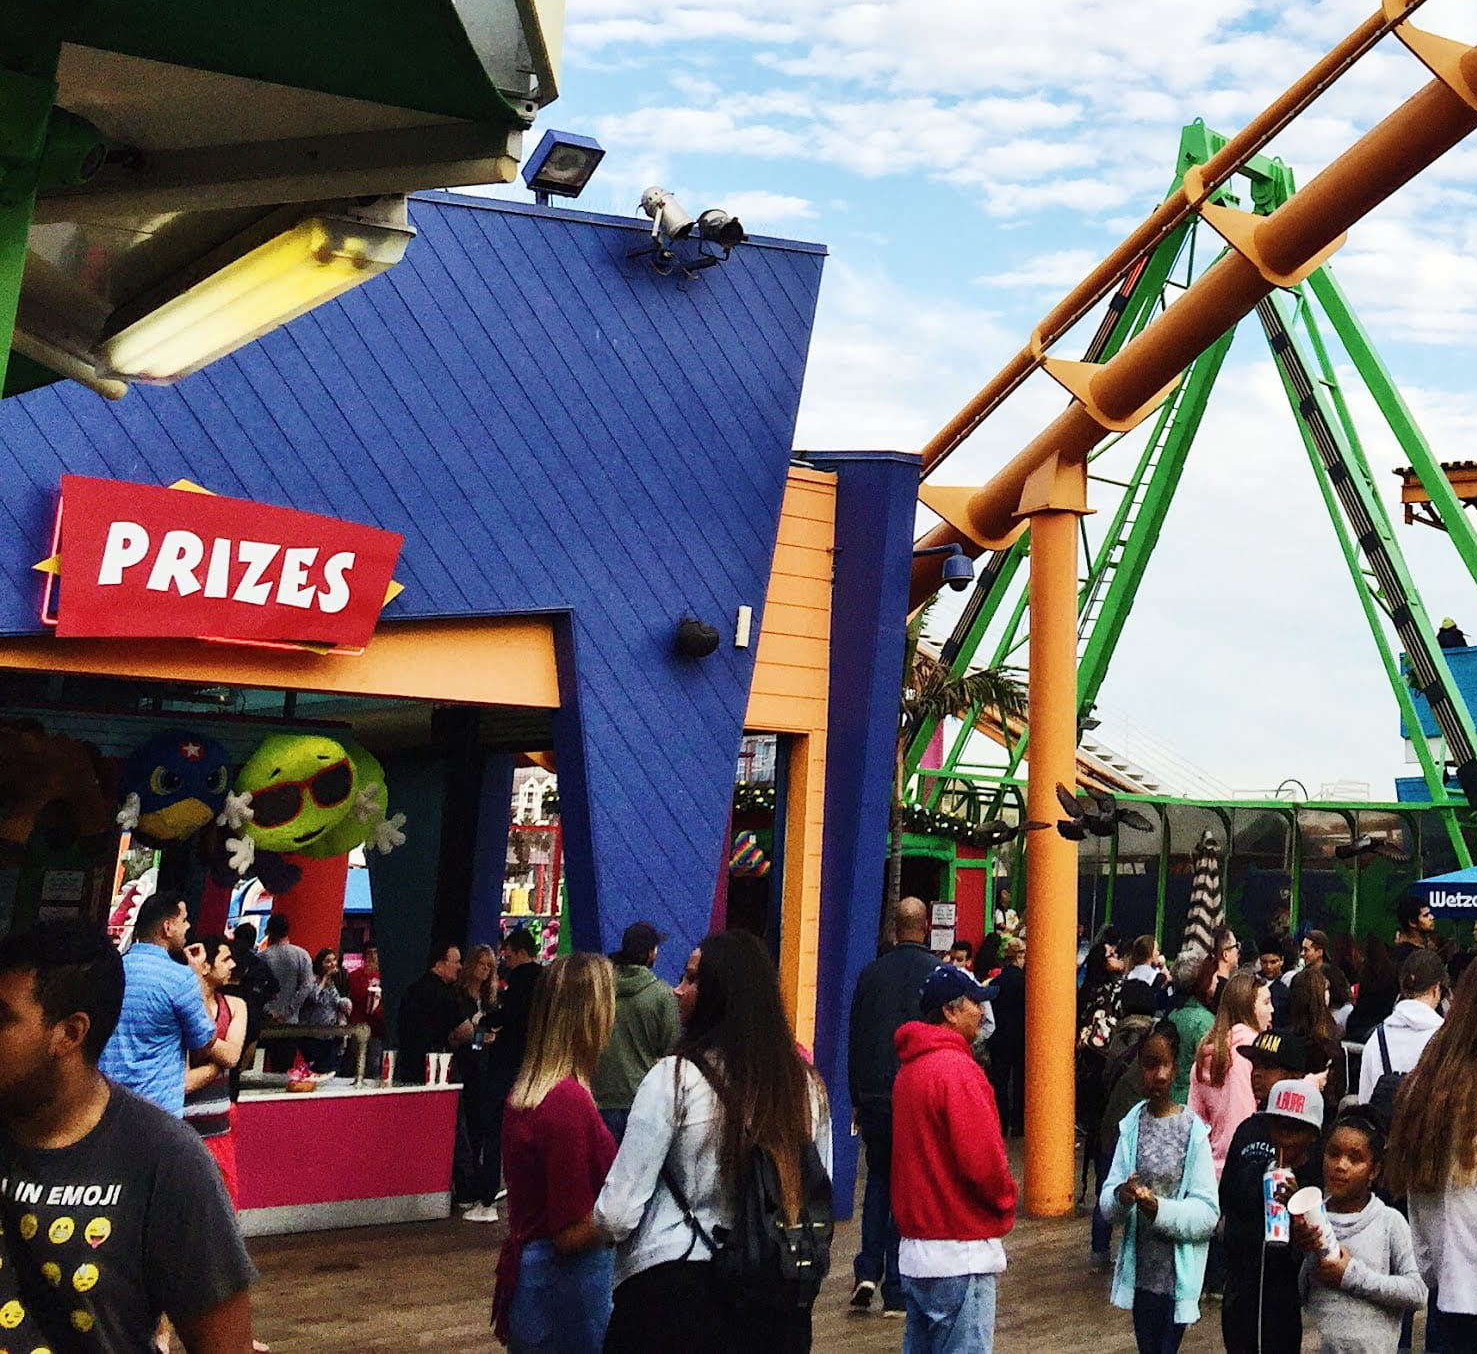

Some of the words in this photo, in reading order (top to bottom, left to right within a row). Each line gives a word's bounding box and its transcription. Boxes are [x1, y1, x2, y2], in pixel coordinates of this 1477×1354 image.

[97, 521, 356, 614] PRIZES
[15, 1181, 43, 1204] IN
[46, 1184, 122, 1206] EMOJI
